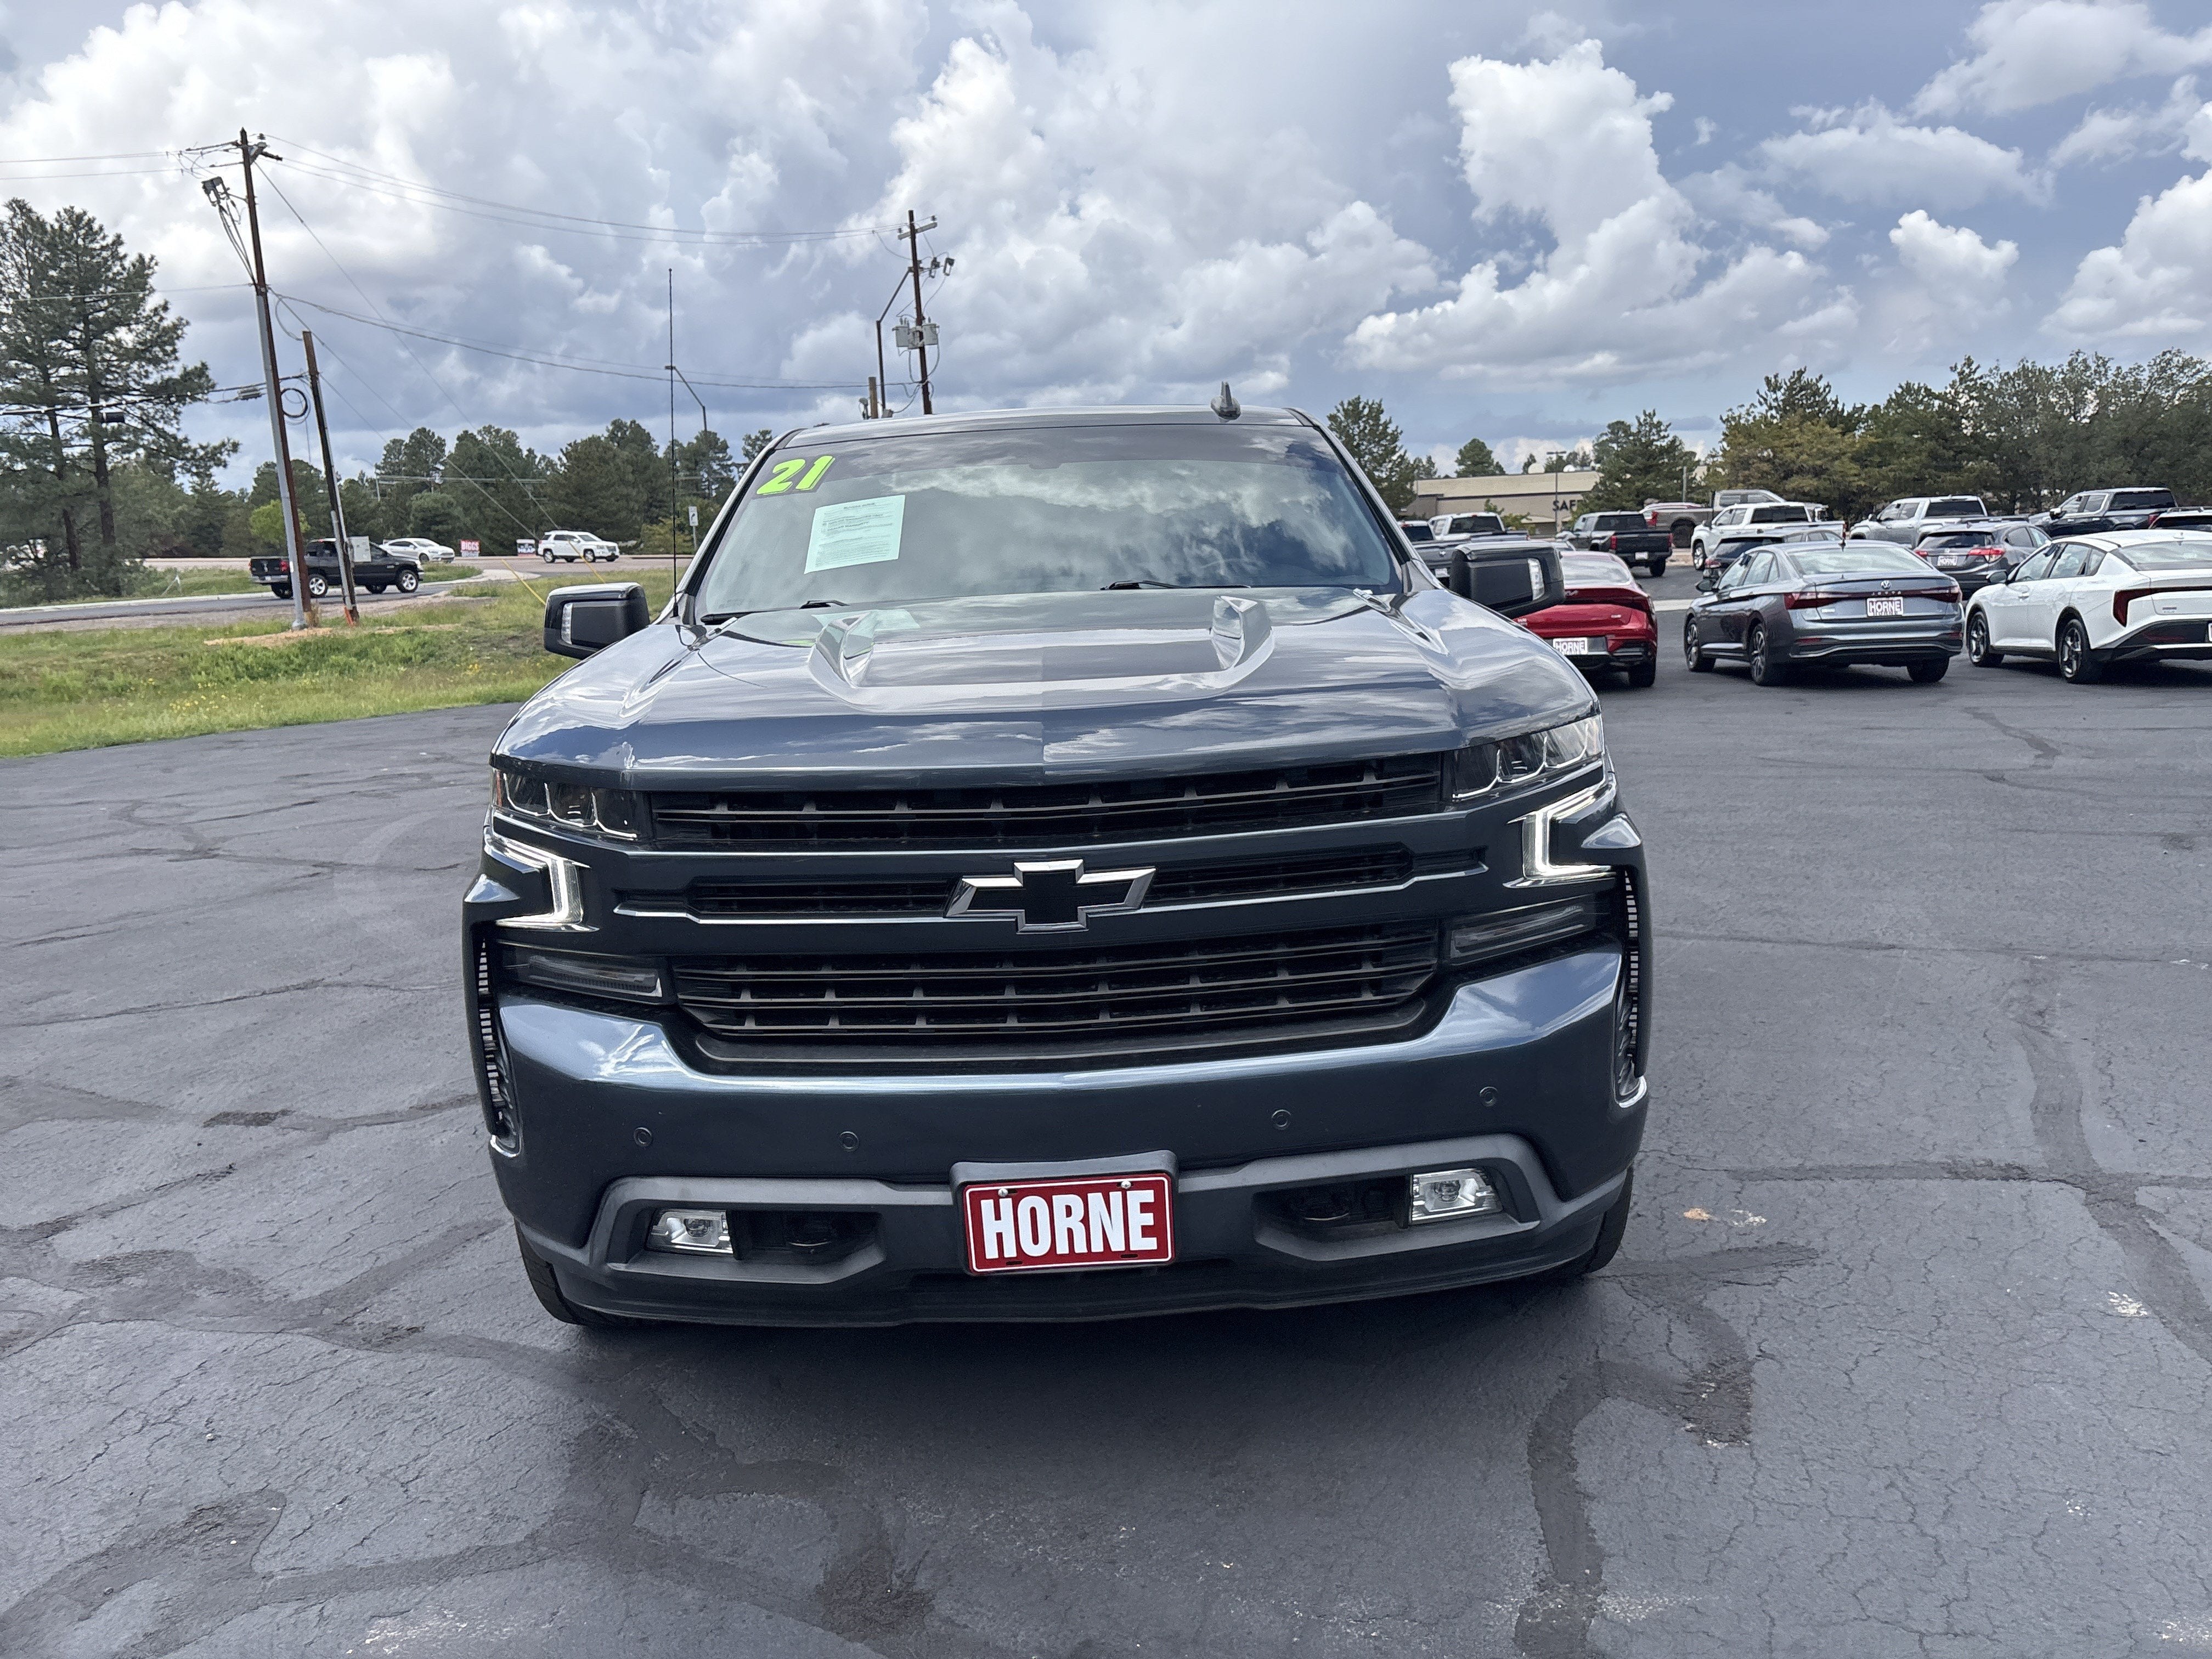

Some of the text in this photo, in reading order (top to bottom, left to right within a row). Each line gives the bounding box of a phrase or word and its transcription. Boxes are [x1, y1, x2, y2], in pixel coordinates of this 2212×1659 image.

[757, 455, 835, 495] 21
[1870, 601, 1900, 613] HORNE
[1555, 641, 1585, 652] HORNE
[980, 1189, 1158, 1259] HORNE
